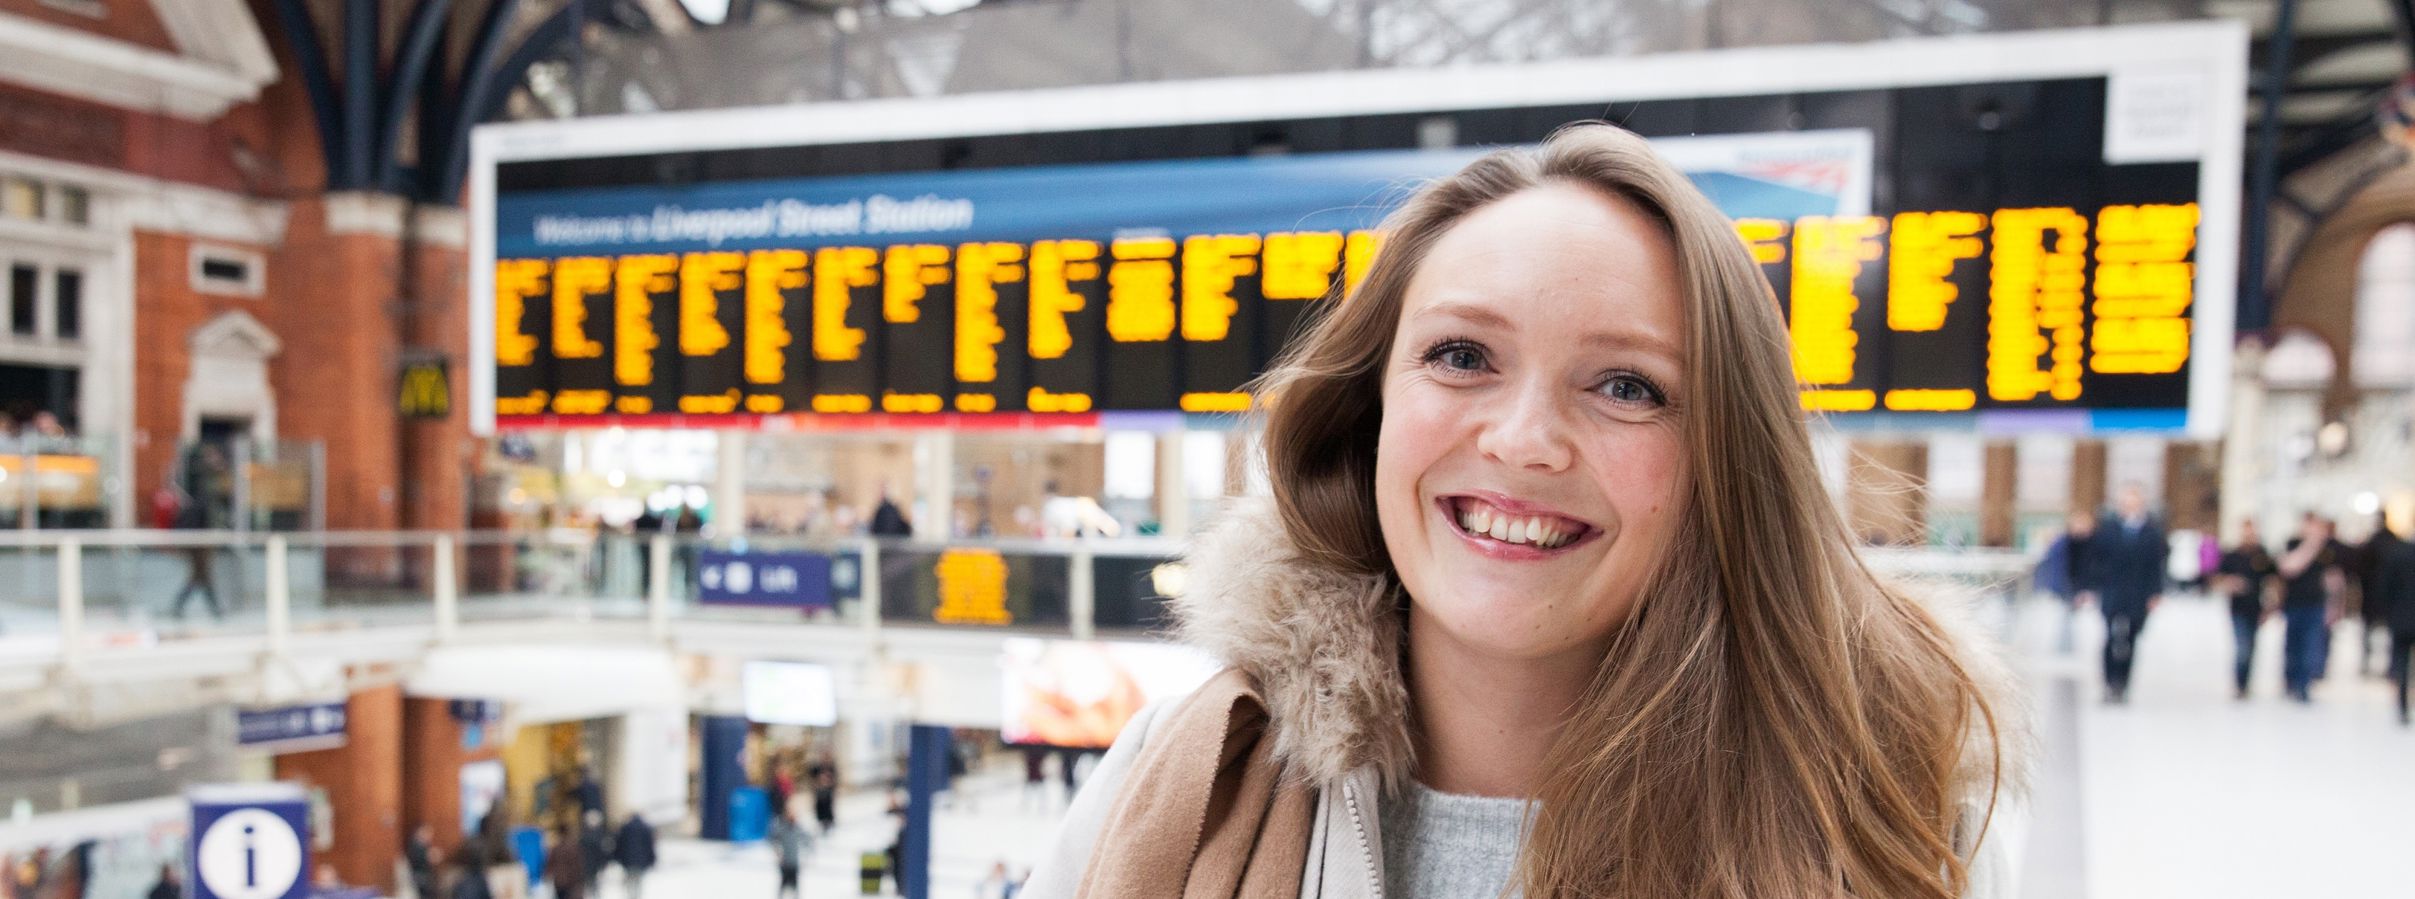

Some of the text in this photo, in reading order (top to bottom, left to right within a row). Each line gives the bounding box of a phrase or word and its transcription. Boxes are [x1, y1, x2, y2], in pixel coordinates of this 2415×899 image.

[534, 215, 624, 245] Welcome
[652, 204, 775, 247] Liverpool
[777, 199, 861, 237] Street
[864, 194, 974, 234] Station
[244, 826, 255, 887] i
